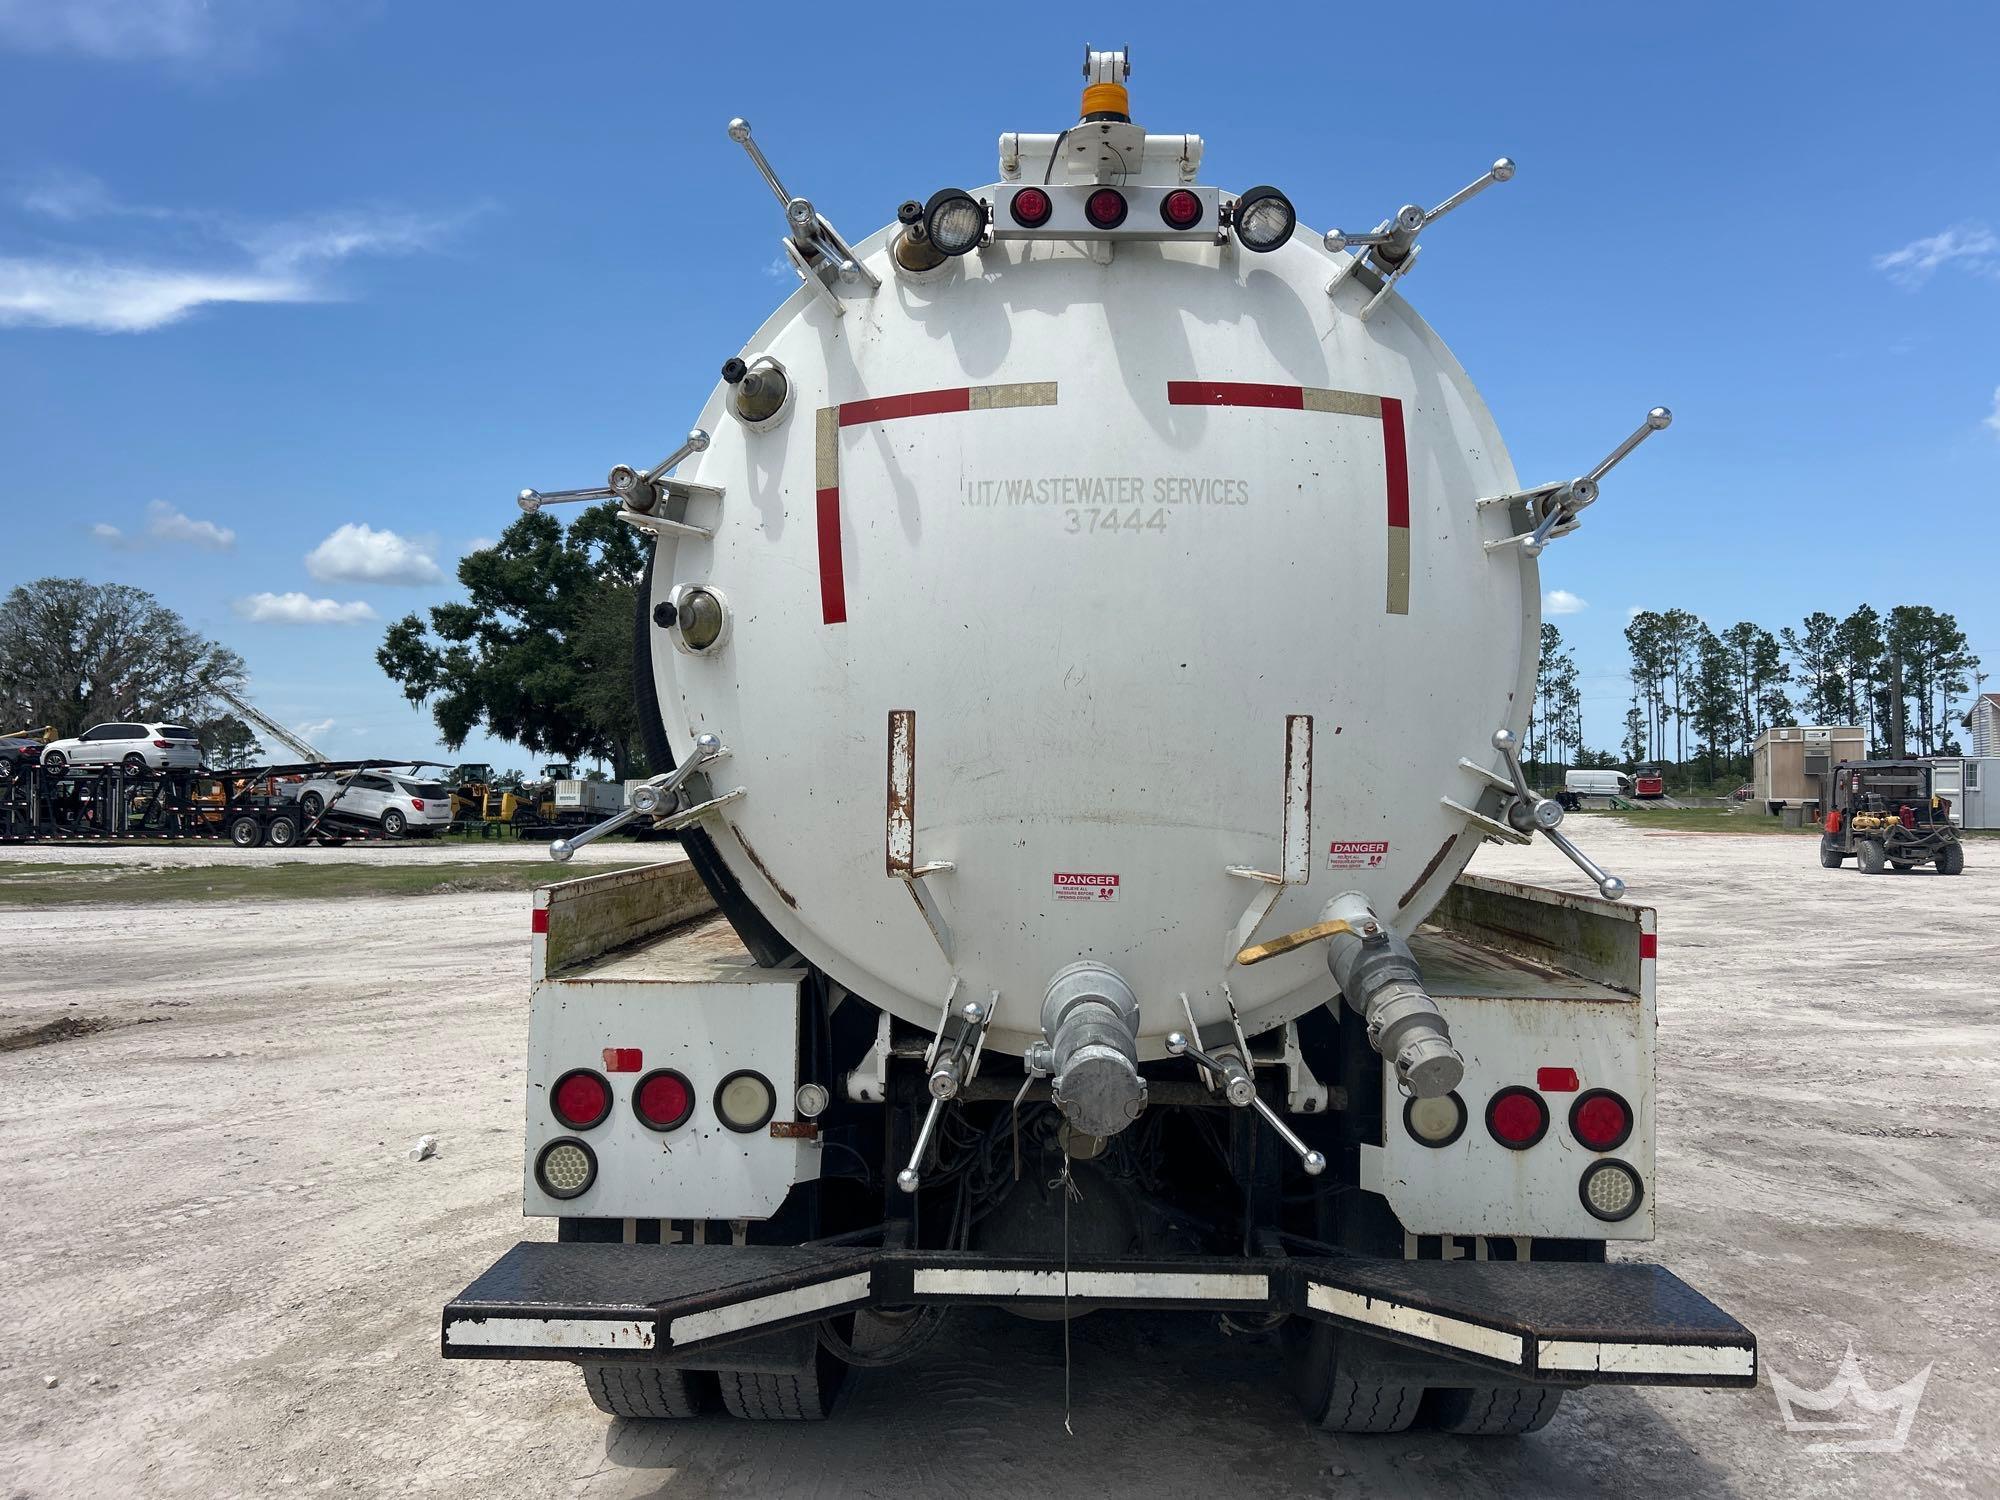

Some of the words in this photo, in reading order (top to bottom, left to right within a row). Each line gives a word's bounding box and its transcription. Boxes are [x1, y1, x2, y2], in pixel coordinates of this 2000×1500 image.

[1153, 477, 1249, 505] SERVICES
[1064, 507, 1167, 534] 37444
[1334, 843, 1384, 852] DANGER
[1058, 875, 1115, 885] DANGER
